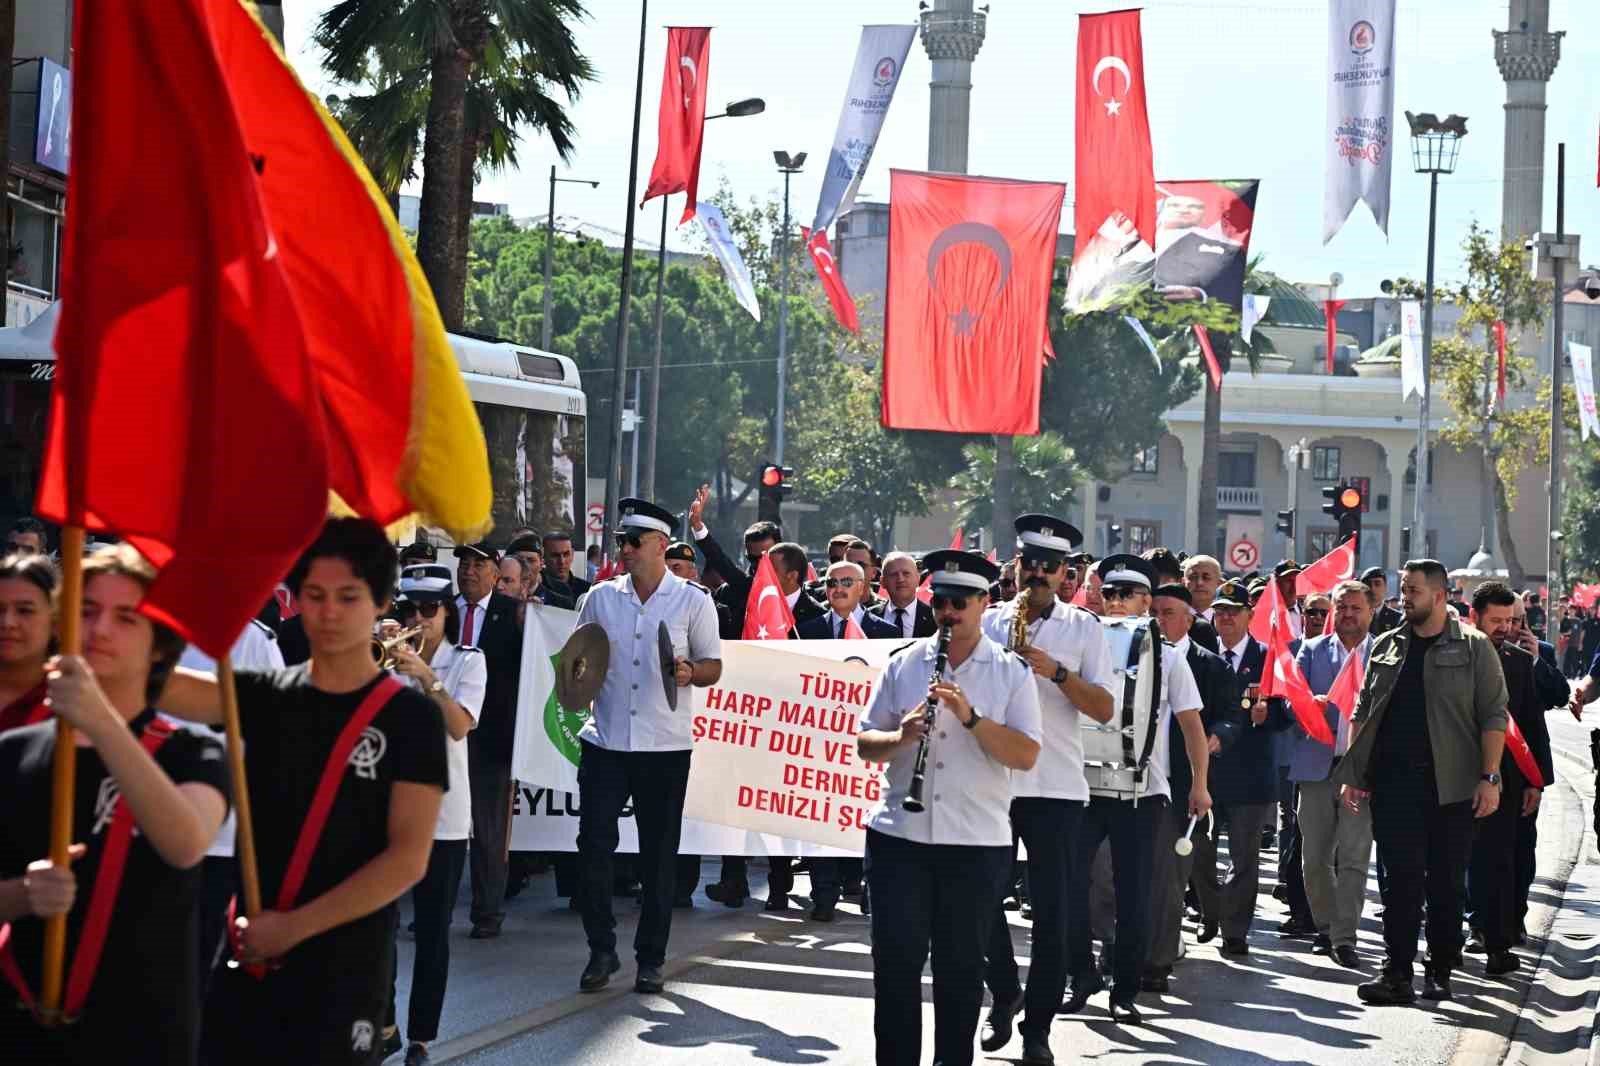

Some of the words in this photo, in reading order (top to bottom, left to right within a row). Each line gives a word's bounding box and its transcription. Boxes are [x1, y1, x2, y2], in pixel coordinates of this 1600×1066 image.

[799, 672, 872, 706] TÜRKİ
[706, 687, 772, 718] HARP
[778, 700, 858, 736] MALÛL
[692, 715, 763, 748] ŞEHİT
[768, 729, 815, 759] DUL
[824, 739, 854, 766] VE
[783, 763, 881, 801] DERNEĞ
[737, 785, 831, 824] DENİZLİ
